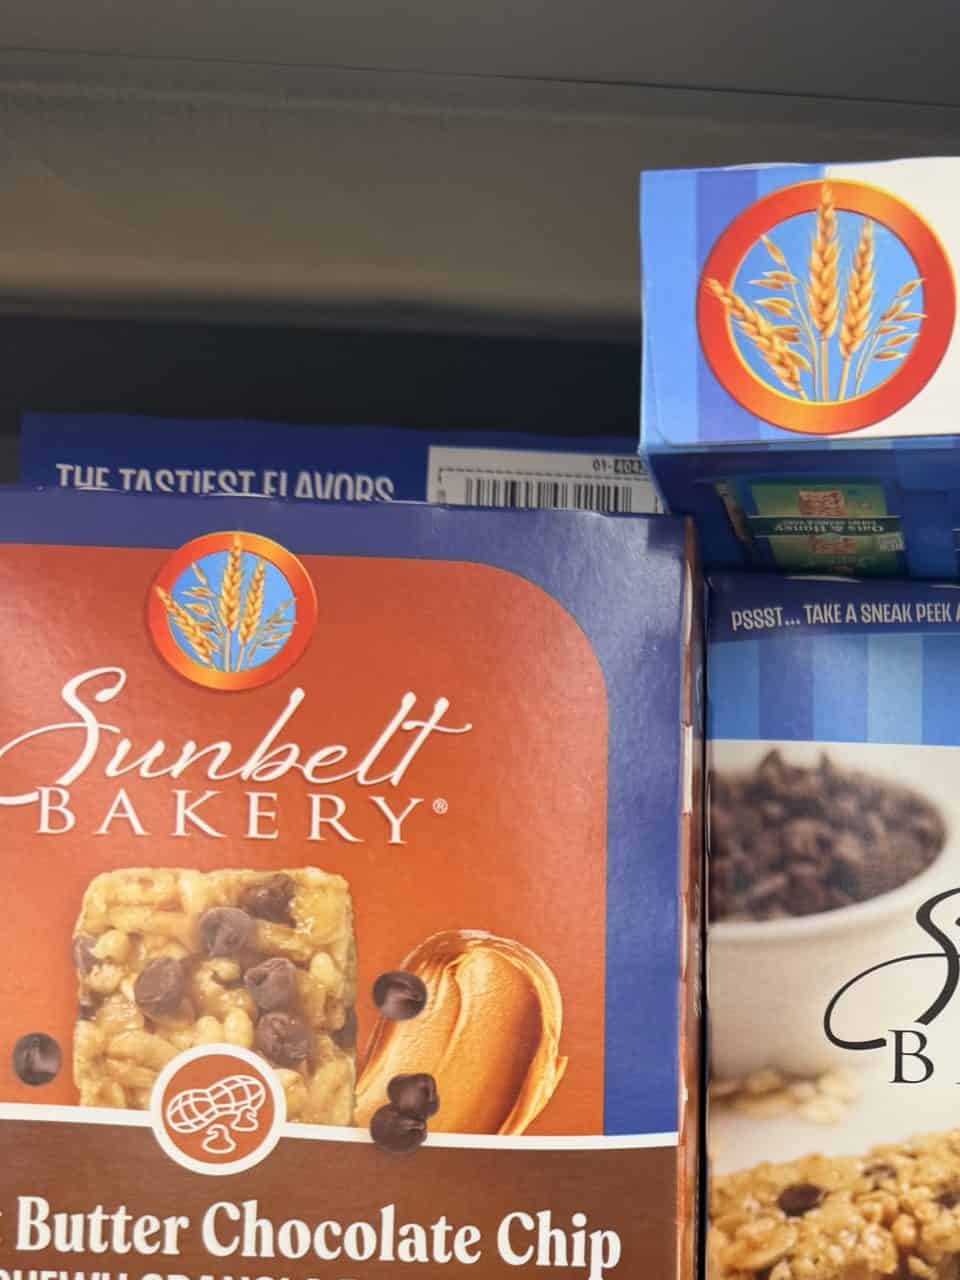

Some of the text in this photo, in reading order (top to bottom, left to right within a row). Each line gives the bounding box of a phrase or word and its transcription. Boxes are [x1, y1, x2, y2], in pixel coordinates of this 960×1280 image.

[803, 603, 842, 626] TAKE
[846, 603, 858, 624] A
[860, 602, 912, 624] SNEAK
[915, 601, 953, 623] PEEK
[0, 666, 472, 805] Sunbelt
[16, 1195, 191, 1256] Butter
[201, 1199, 483, 1266] Chocolate
